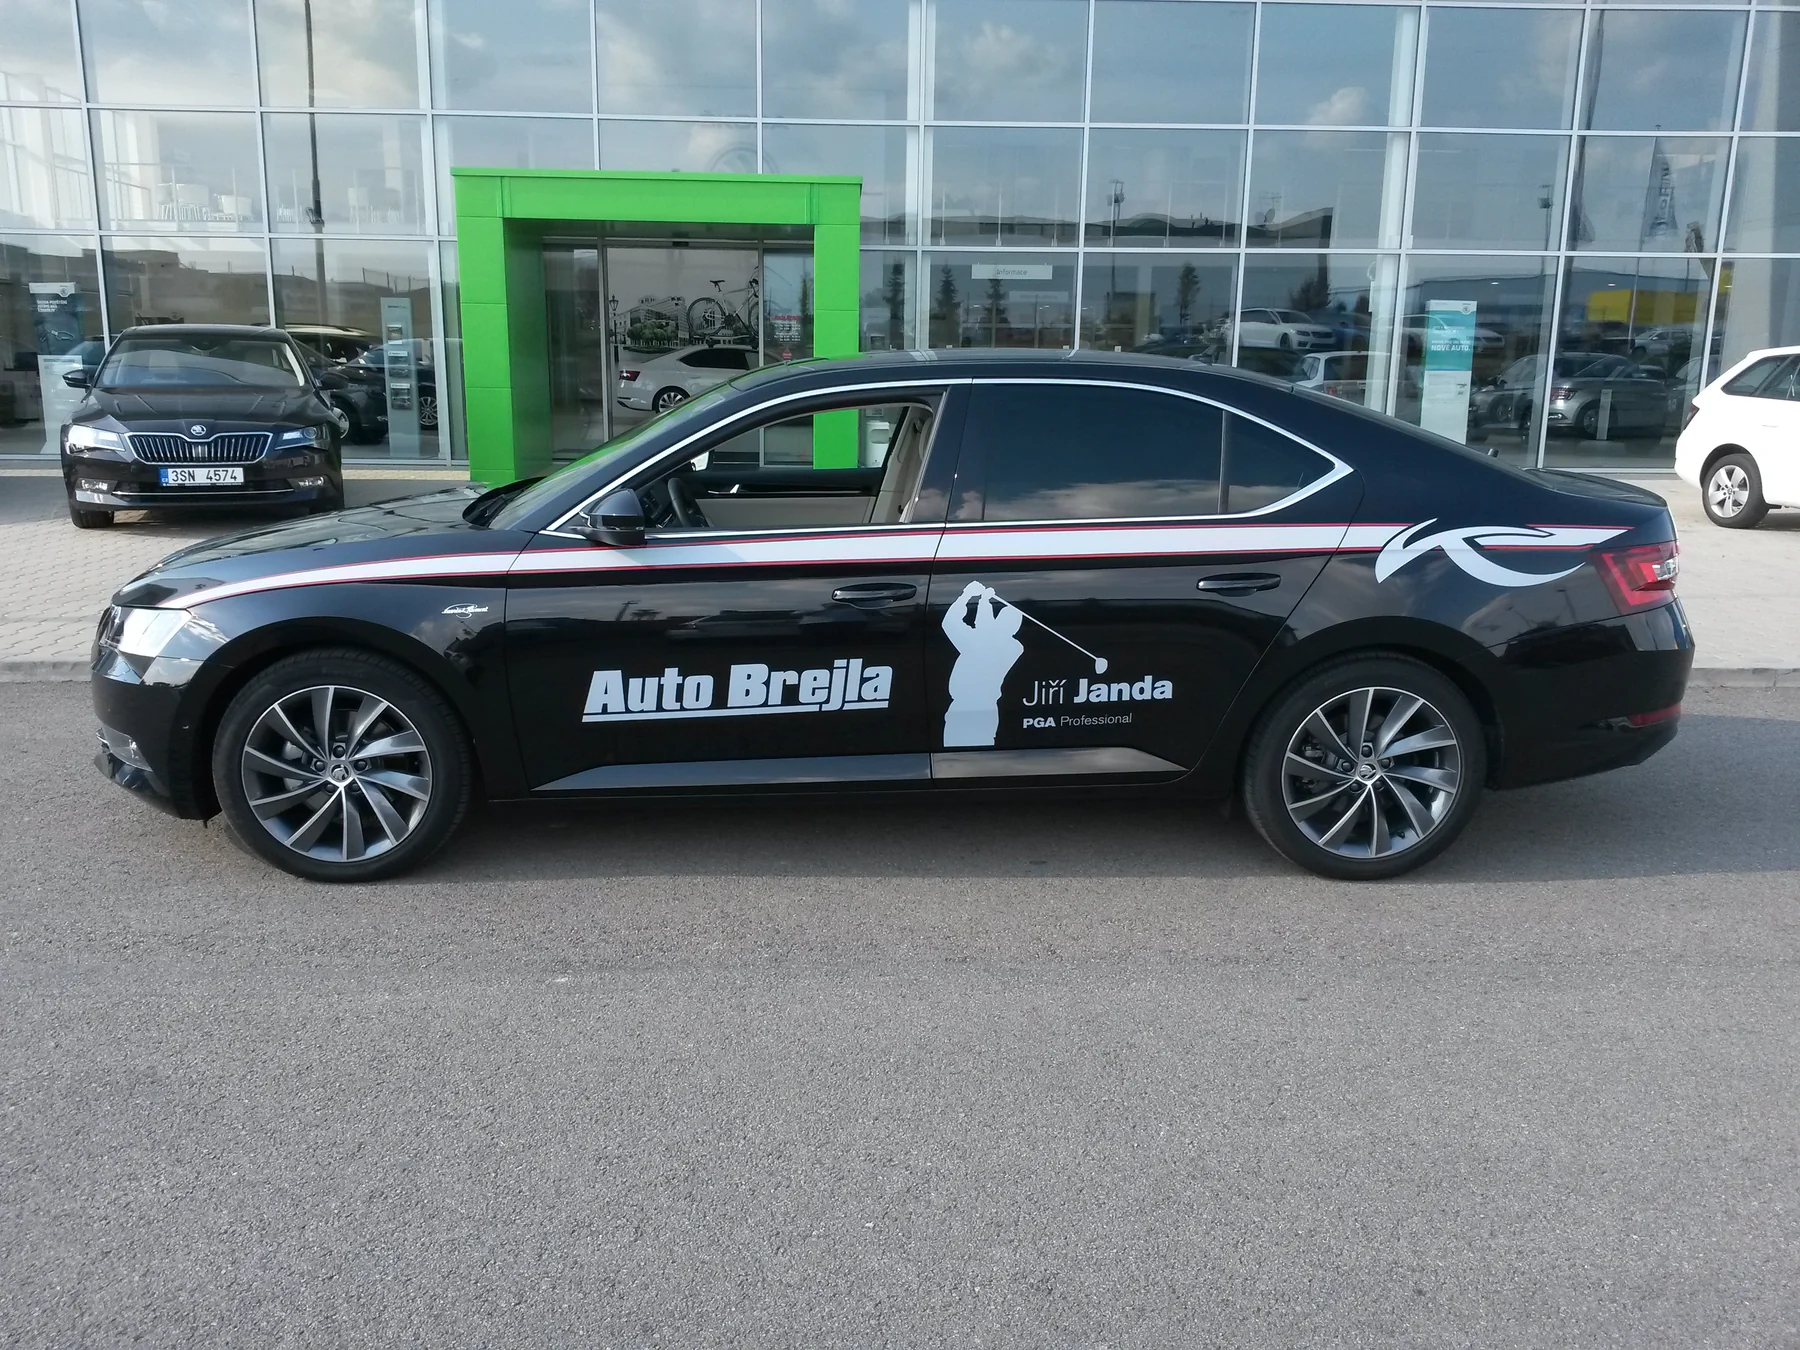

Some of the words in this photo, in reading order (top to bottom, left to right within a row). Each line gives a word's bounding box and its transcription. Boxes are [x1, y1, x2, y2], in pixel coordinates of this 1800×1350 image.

[996, 268, 1028, 277] Informace
[171, 469, 196, 482] 3SN
[206, 469, 238, 482] 4574
[584, 667, 714, 712] Auto
[727, 658, 893, 711] Brejla
[1022, 679, 1067, 706] Jiří
[1073, 675, 1173, 703] Janda
[1022, 717, 1057, 728] PGA
[1060, 713, 1132, 726] Professional
